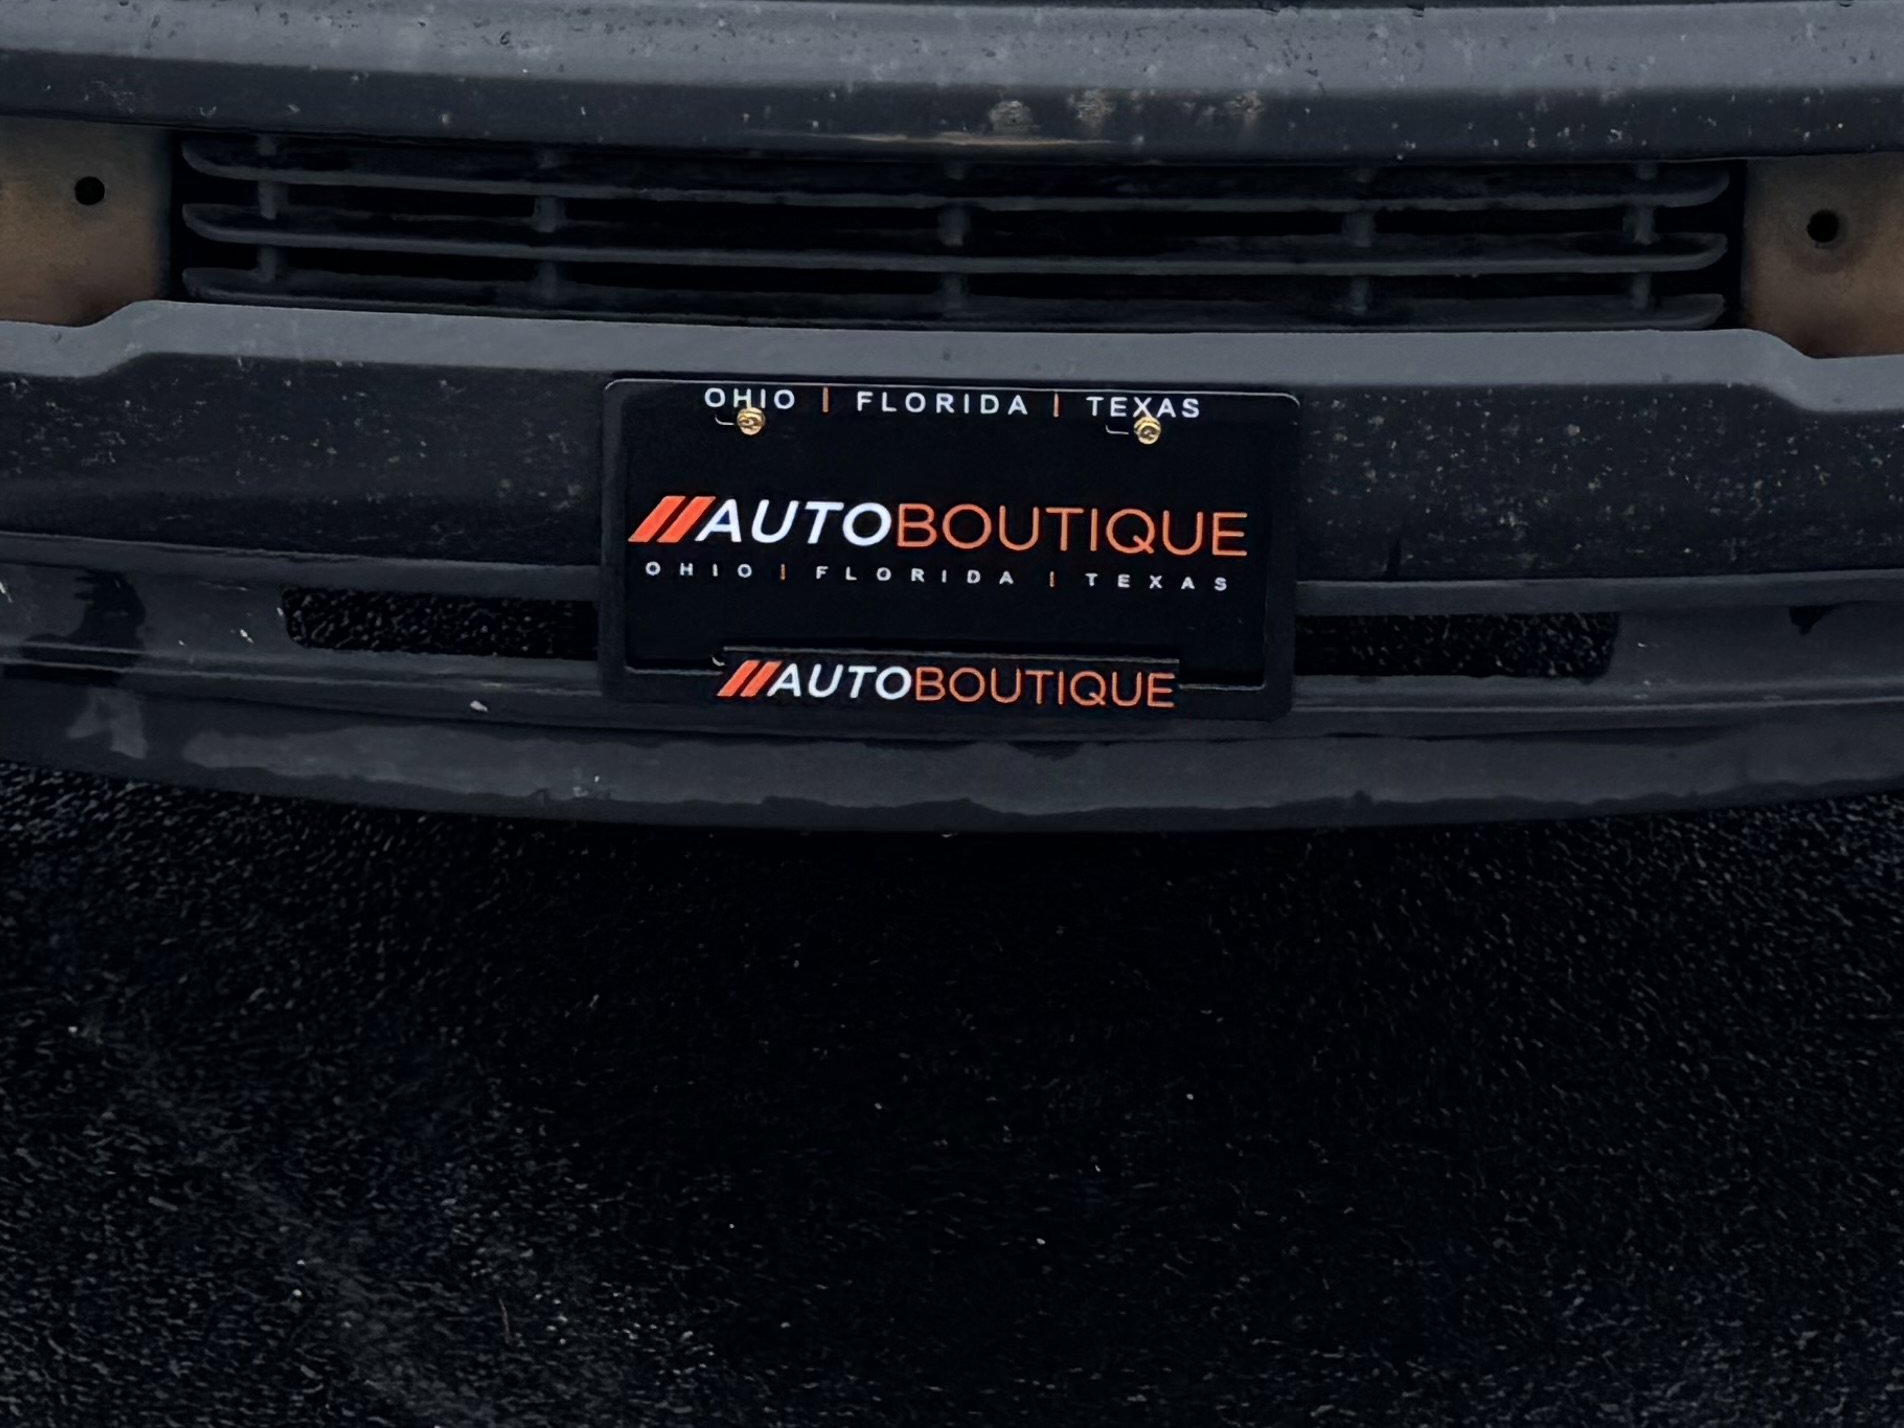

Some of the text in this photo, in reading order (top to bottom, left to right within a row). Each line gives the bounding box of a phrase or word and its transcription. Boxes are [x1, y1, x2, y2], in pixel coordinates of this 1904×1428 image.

[704, 387, 1200, 419] OHIO FLORIDA TEXAS
[694, 498, 1248, 557] AUTOBOUTIQUE
[645, 561, 1228, 592] OHIO FLORIDA TEXAS
[766, 662, 1176, 708] AUTOBOUTIQUE
